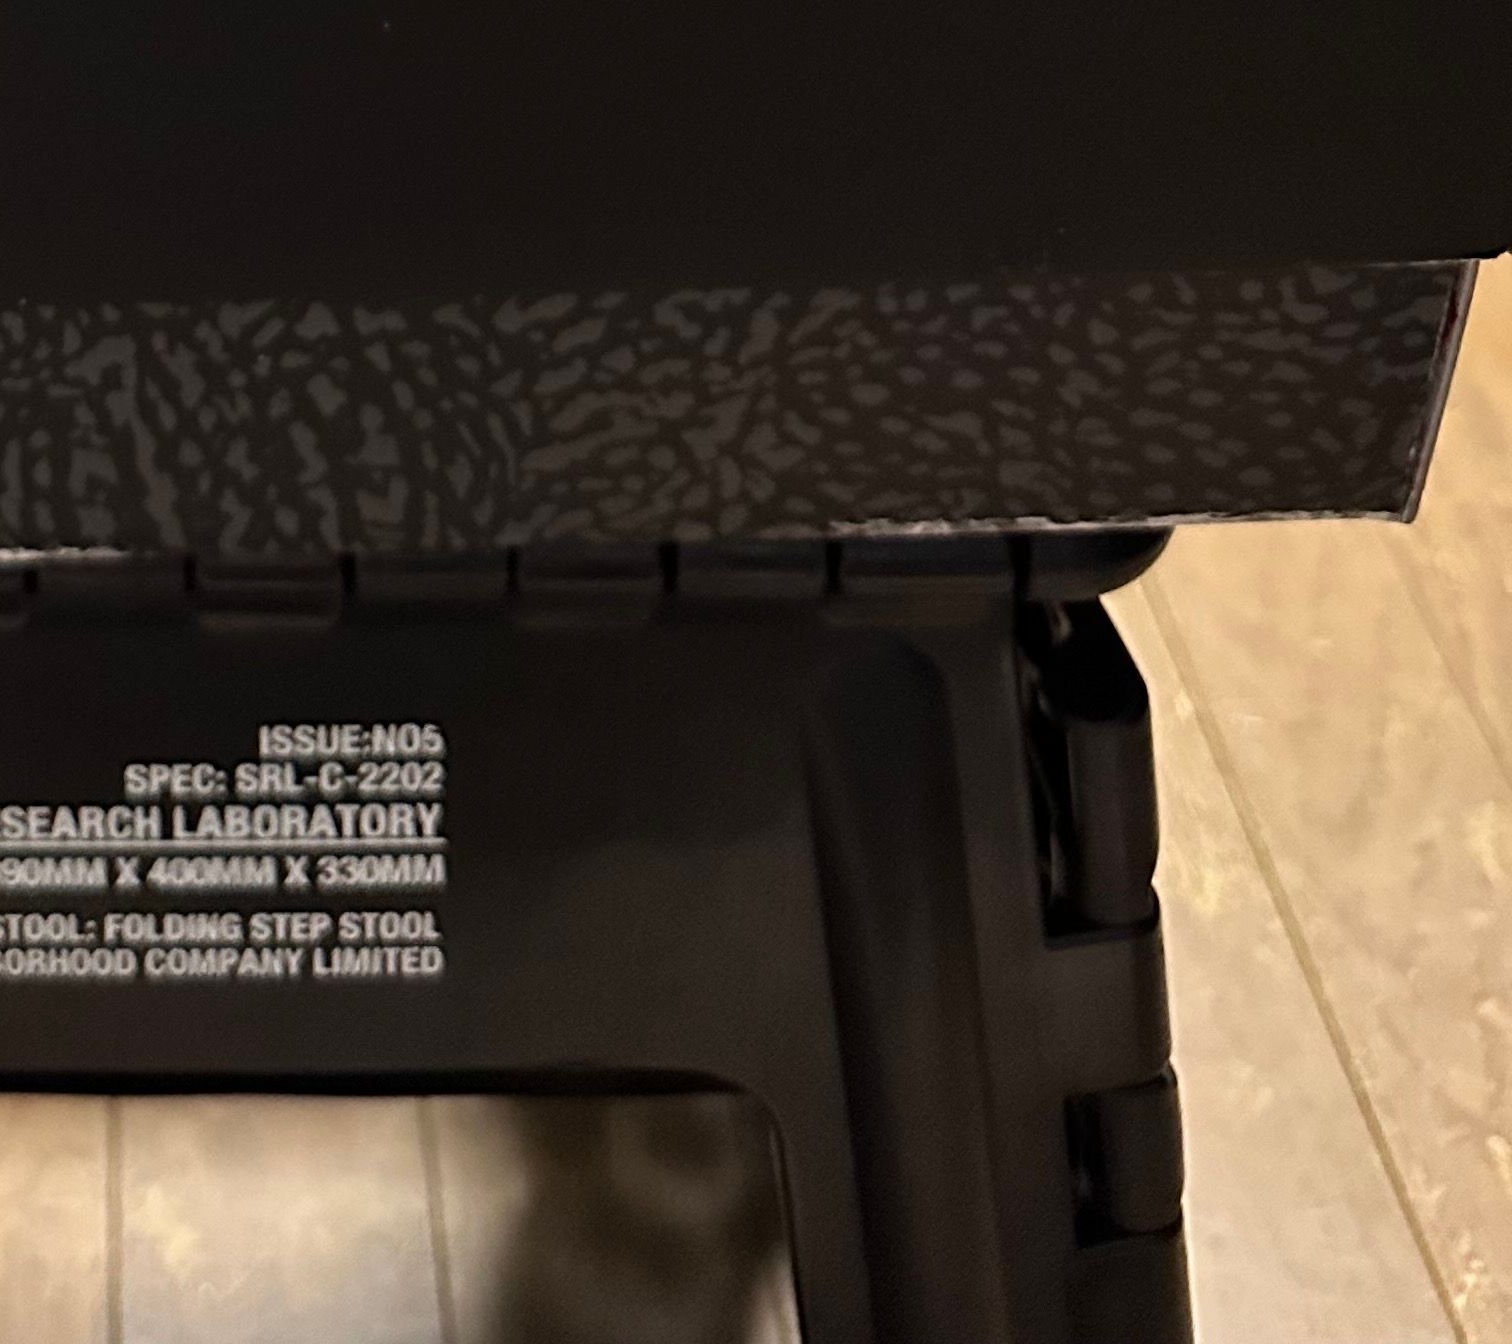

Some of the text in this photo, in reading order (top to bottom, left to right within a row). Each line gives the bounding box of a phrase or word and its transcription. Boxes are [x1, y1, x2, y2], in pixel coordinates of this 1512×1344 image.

[124, 761, 444, 798] SPEC: SRL-C-2202
[172, 803, 443, 839] LABORATORY
[114, 857, 140, 889] X
[145, 857, 278, 889] 400MM
[283, 855, 311, 888] X
[316, 854, 446, 889] 330MM
[103, 912, 243, 942] FOLDING
[249, 912, 333, 942] STEP
[338, 912, 443, 941] STOOL
[144, 947, 303, 976] COMPANY
[312, 946, 445, 976] LIMITED
